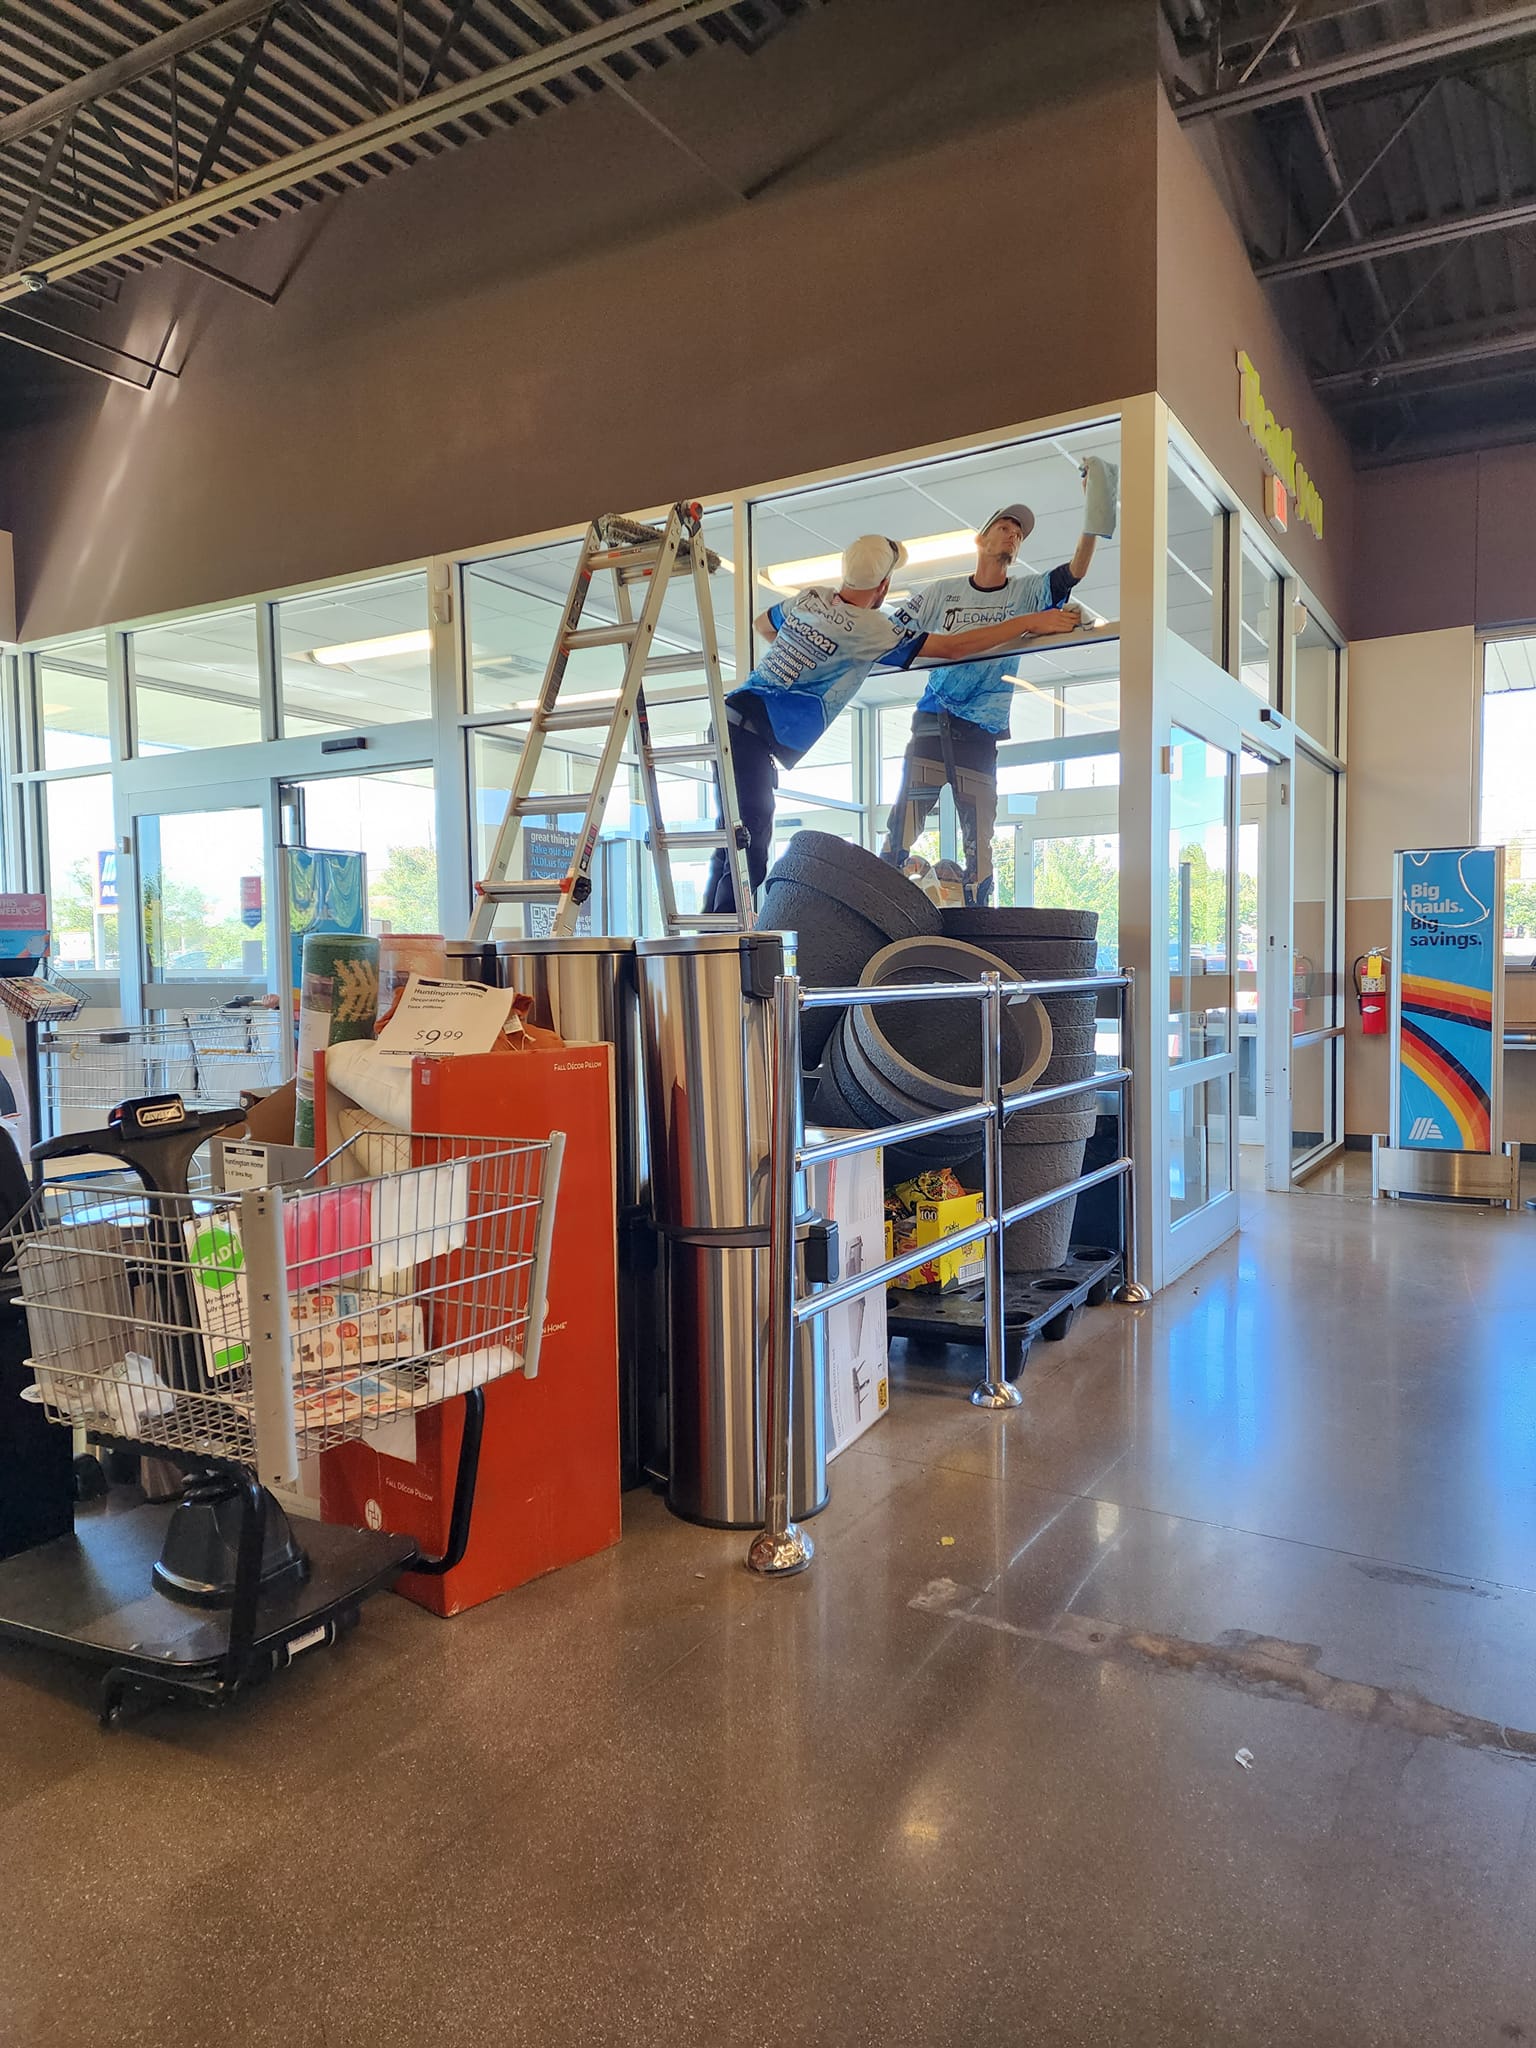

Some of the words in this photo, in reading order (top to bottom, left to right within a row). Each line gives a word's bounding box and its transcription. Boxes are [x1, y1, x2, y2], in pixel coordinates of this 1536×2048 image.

[530, 832, 550, 843] great
[551, 834, 571, 846] thing
[531, 845, 548, 855] Take
[549, 848, 561, 857] our
[1411, 882, 1440, 900] Big
[1411, 899, 1464, 914] hauls.
[1411, 916, 1438, 933] Big
[1410, 931, 1482, 949] savings.
[414, 988, 459, 997] Huntington
[920, 1210, 938, 1220] 100
[385, 1477, 397, 1489] FALL
[414, 1488, 434, 1502] PILLOW
